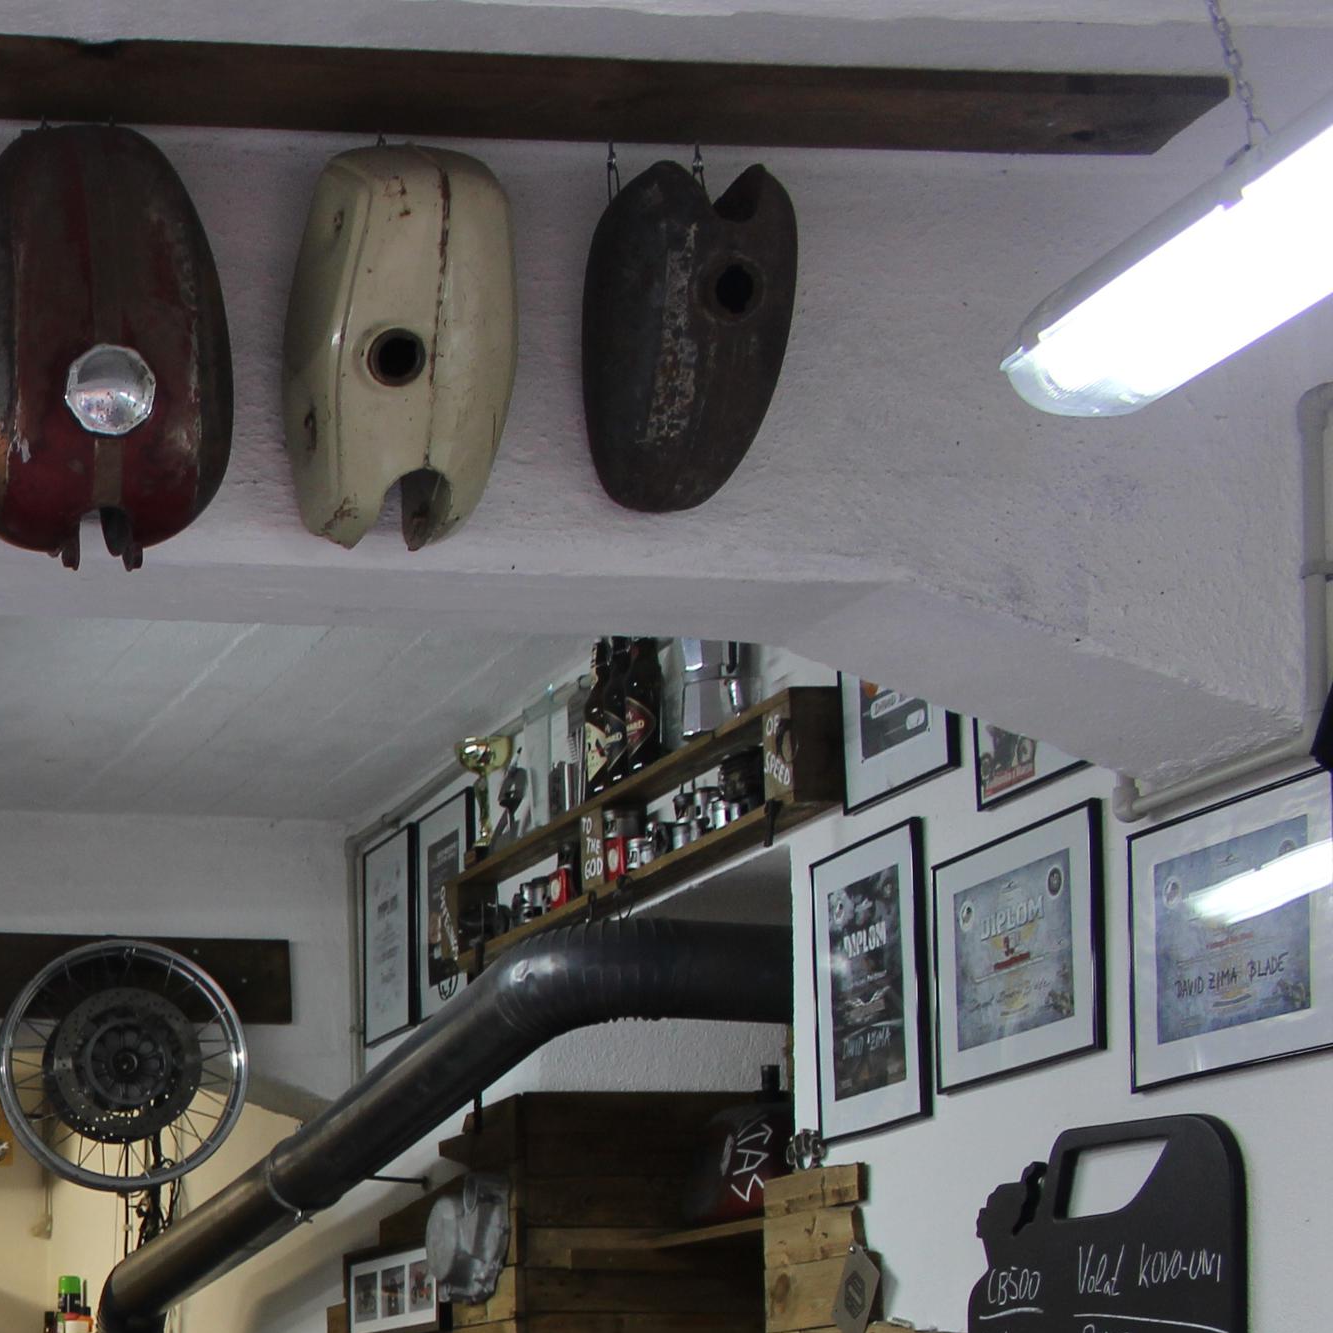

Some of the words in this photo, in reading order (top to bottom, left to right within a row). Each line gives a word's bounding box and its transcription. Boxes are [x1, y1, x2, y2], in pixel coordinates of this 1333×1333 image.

[763, 752, 791, 786] SPEED
[582, 817, 593, 835] TO
[586, 837, 602, 854] THE
[584, 857, 604, 880] GOD
[981, 895, 1046, 942] DIPLOM
[843, 921, 887, 959] DIPLOM
[1174, 976, 1204, 998] DAVID
[1248, 951, 1290, 983] BLADE
